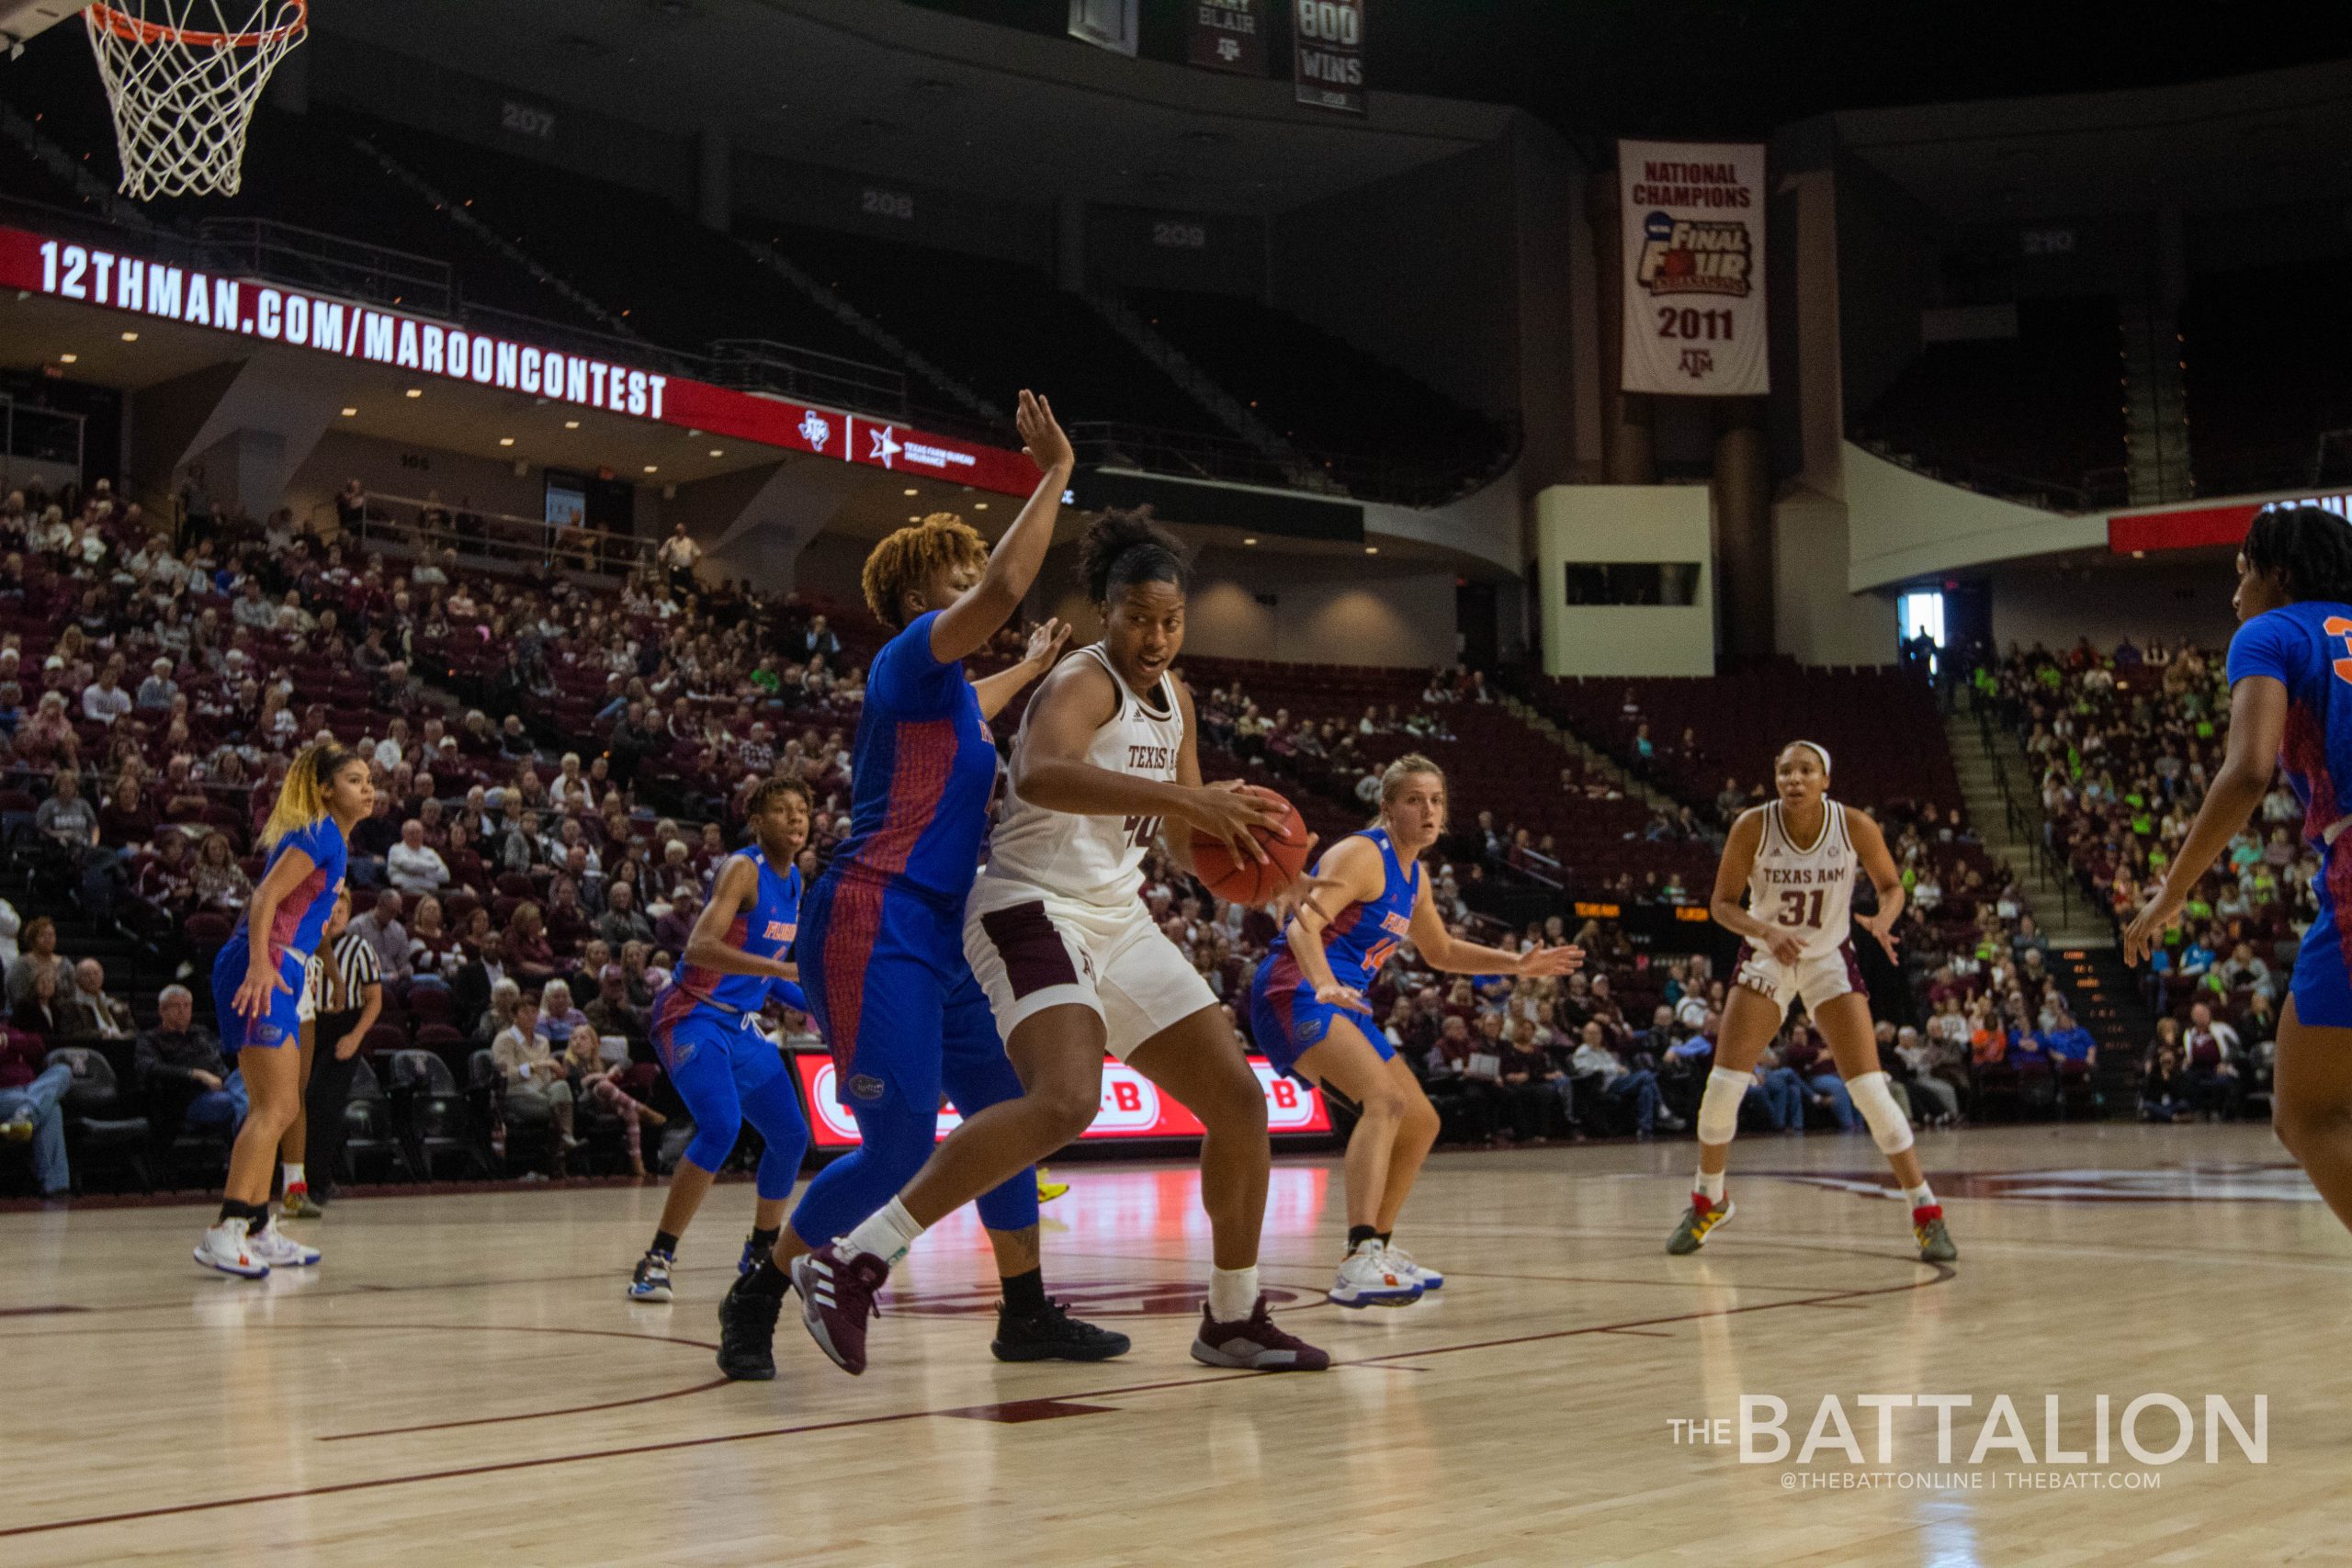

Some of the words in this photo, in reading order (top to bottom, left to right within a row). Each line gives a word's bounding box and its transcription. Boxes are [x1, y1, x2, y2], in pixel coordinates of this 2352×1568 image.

[1197, 6, 1255, 35] BLAIR
[1298, 1, 1359, 44] 800
[1300, 48, 1363, 85] WINS
[503, 101, 554, 137] 207
[1645, 162, 1737, 184] NATIONAL
[1634, 185, 1750, 208] CHAMPIONS
[1672, 221, 1747, 251] FINAL
[40, 241, 666, 419] 12THMAN.COM/MAROONCONTEST
[1658, 308, 1733, 340] 2011
[1128, 745, 1168, 769] TEXAS
[1764, 868, 1812, 884] TEXAS
[1817, 868, 1845, 885] A&M
[1778, 890, 1824, 929] 31
